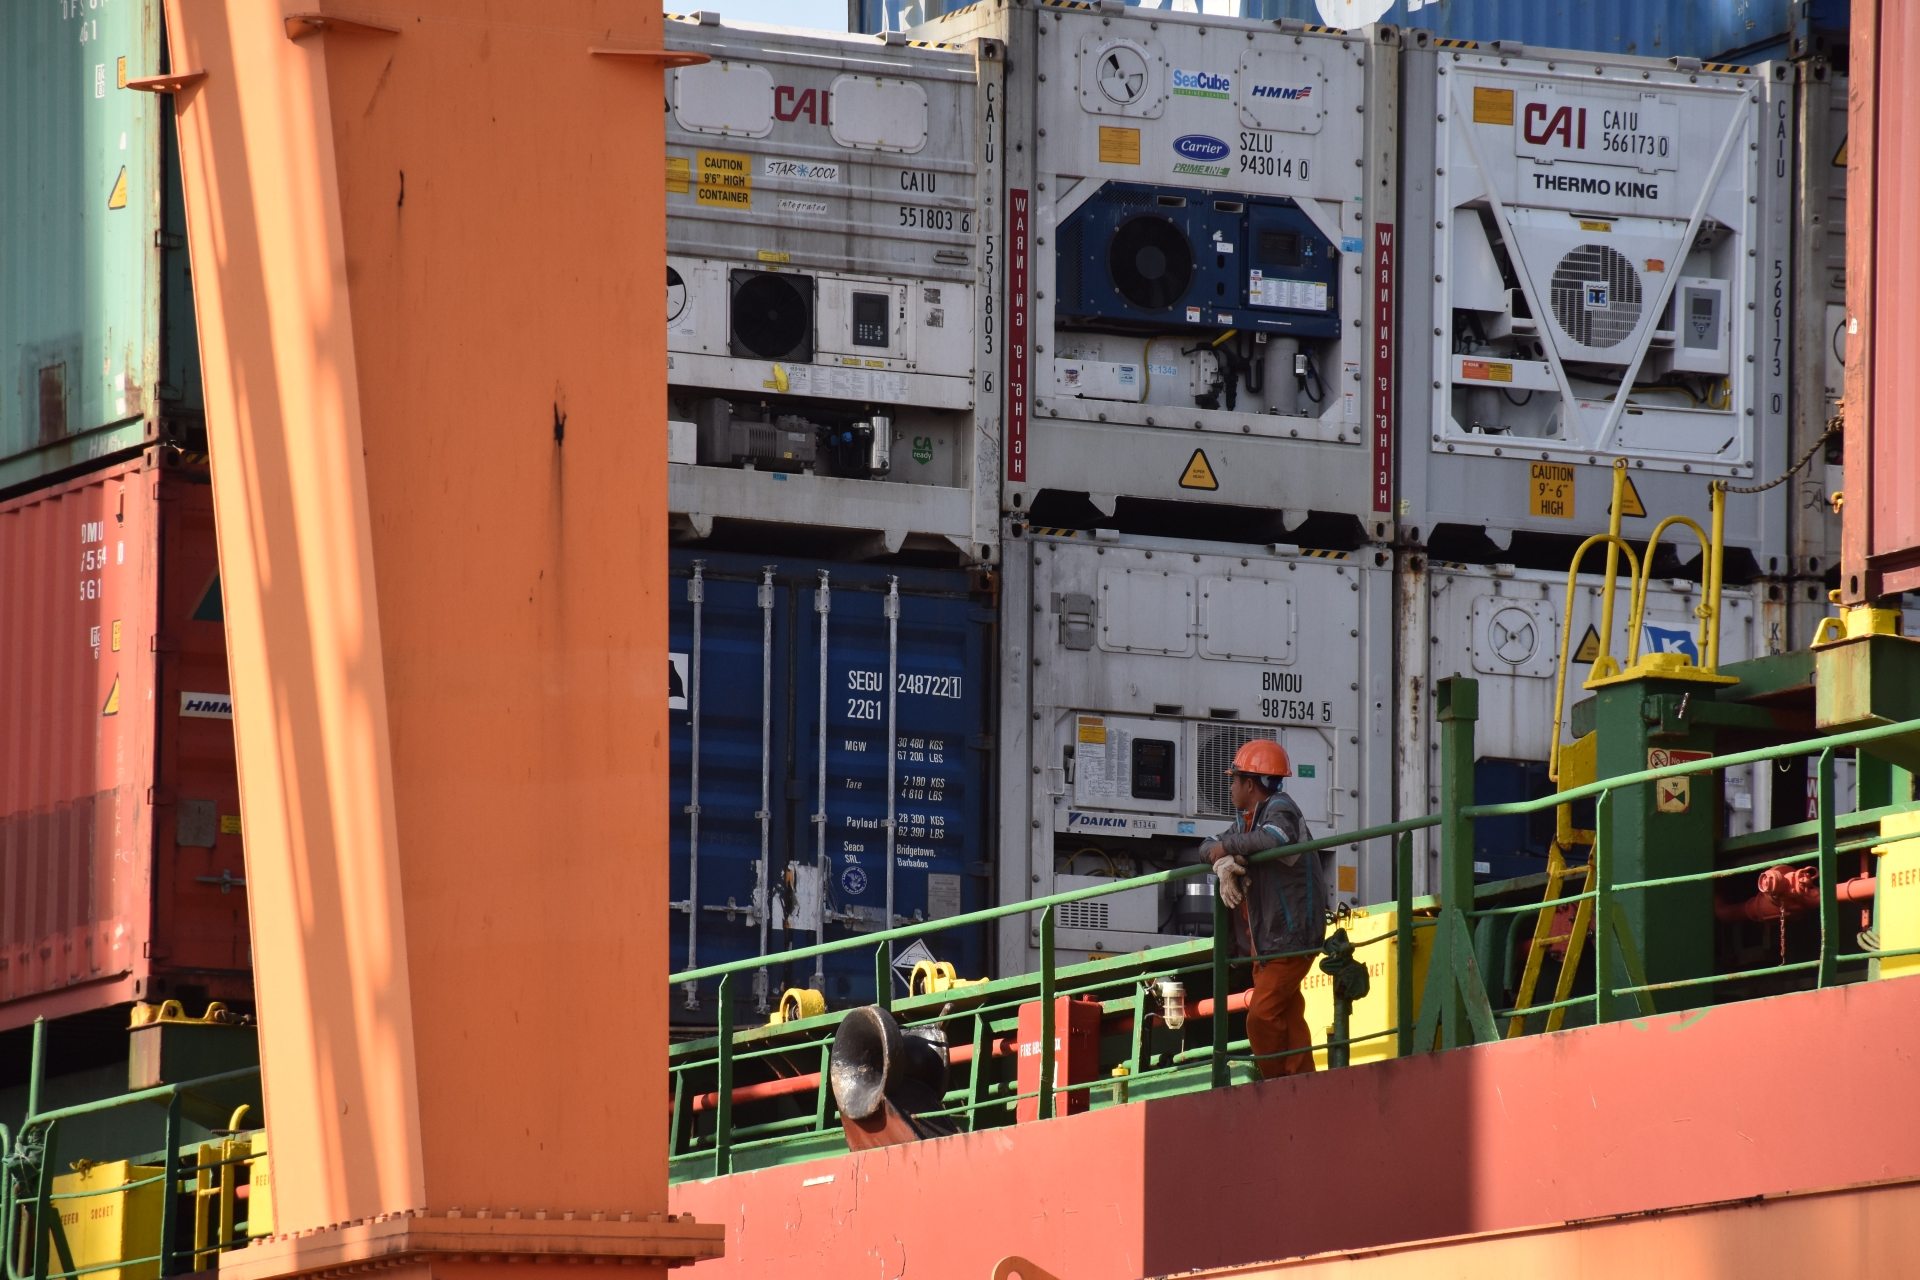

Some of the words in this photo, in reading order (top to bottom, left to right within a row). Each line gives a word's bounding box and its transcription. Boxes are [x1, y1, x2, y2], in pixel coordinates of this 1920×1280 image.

[1173, 70, 1230, 91] SeaCube
[1252, 85, 1297, 99] HMM
[774, 85, 829, 126] CAI
[985, 82, 995, 164] CAIU
[1524, 102, 1587, 149] CAI
[1603, 110, 1638, 132] CAIU
[1181, 139, 1223, 155] Carrier
[1240, 131, 1273, 153] SZLU
[1603, 132, 1655, 155] 566173
[1658, 137, 1669, 157] 0
[1777, 100, 1786, 178] CAIU
[704, 157, 743, 171] CAUTION
[766, 162, 797, 176] STAR
[808, 166, 838, 179] COOL
[1174, 162, 1226, 176] PRIMELINE
[1240, 154, 1292, 178] 943014
[1299, 159, 1309, 180] 0
[724, 175, 745, 187] HIGH
[901, 171, 936, 193] CAIU
[1533, 174, 1611, 195] THERMO
[1615, 181, 1658, 200] KING
[699, 188, 748, 203] CONTAINER
[777, 200, 826, 212] Integrated
[900, 207, 953, 231] 551803
[960, 212, 972, 232] 6
[983, 235, 993, 355] 551803
[1773, 260, 1782, 377] 566173
[983, 372, 993, 392] 6
[913, 436, 933, 450] CA
[914, 452, 932, 460] ready
[1532, 464, 1574, 482] CAUTION
[1541, 500, 1564, 515] HIGH
[848, 670, 883, 692] SEGU
[1262, 671, 1303, 693] BMOU
[185, 700, 232, 713] HMM
[847, 699, 881, 720] 22G1
[1262, 698, 1314, 720] 987534
[1322, 702, 1332, 722] 5
[845, 740, 867, 752] MGW
[897, 738, 907, 748] 30
[909, 739, 924, 749] 480
[929, 740, 944, 751] KGS
[897, 751, 906, 761] 67
[909, 751, 924, 762] 200
[929, 753, 944, 764] LBS
[846, 778, 863, 789] Tare
[903, 775, 909, 786] 2
[912, 776, 926, 787] 180
[930, 778, 945, 789] KGS
[901, 788, 906, 799] 4
[908, 789, 924, 800] 810
[928, 790, 943, 801] LBS
[846, 816, 878, 830] Payload
[898, 813, 908, 823] 28
[910, 814, 925, 825] 300
[930, 815, 945, 826] KGS
[1080, 816, 1128, 828] DAIKIN
[898, 826, 907, 836] 62
[910, 827, 925, 838] 390
[929, 828, 944, 839] LBS
[843, 840, 864, 852] Seaco
[896, 844, 936, 858] Bridgetown,
[897, 857, 929, 868] Barbados
[1891, 868, 1920, 888] REEF
[1020, 1043, 1031, 1057] FIRE
